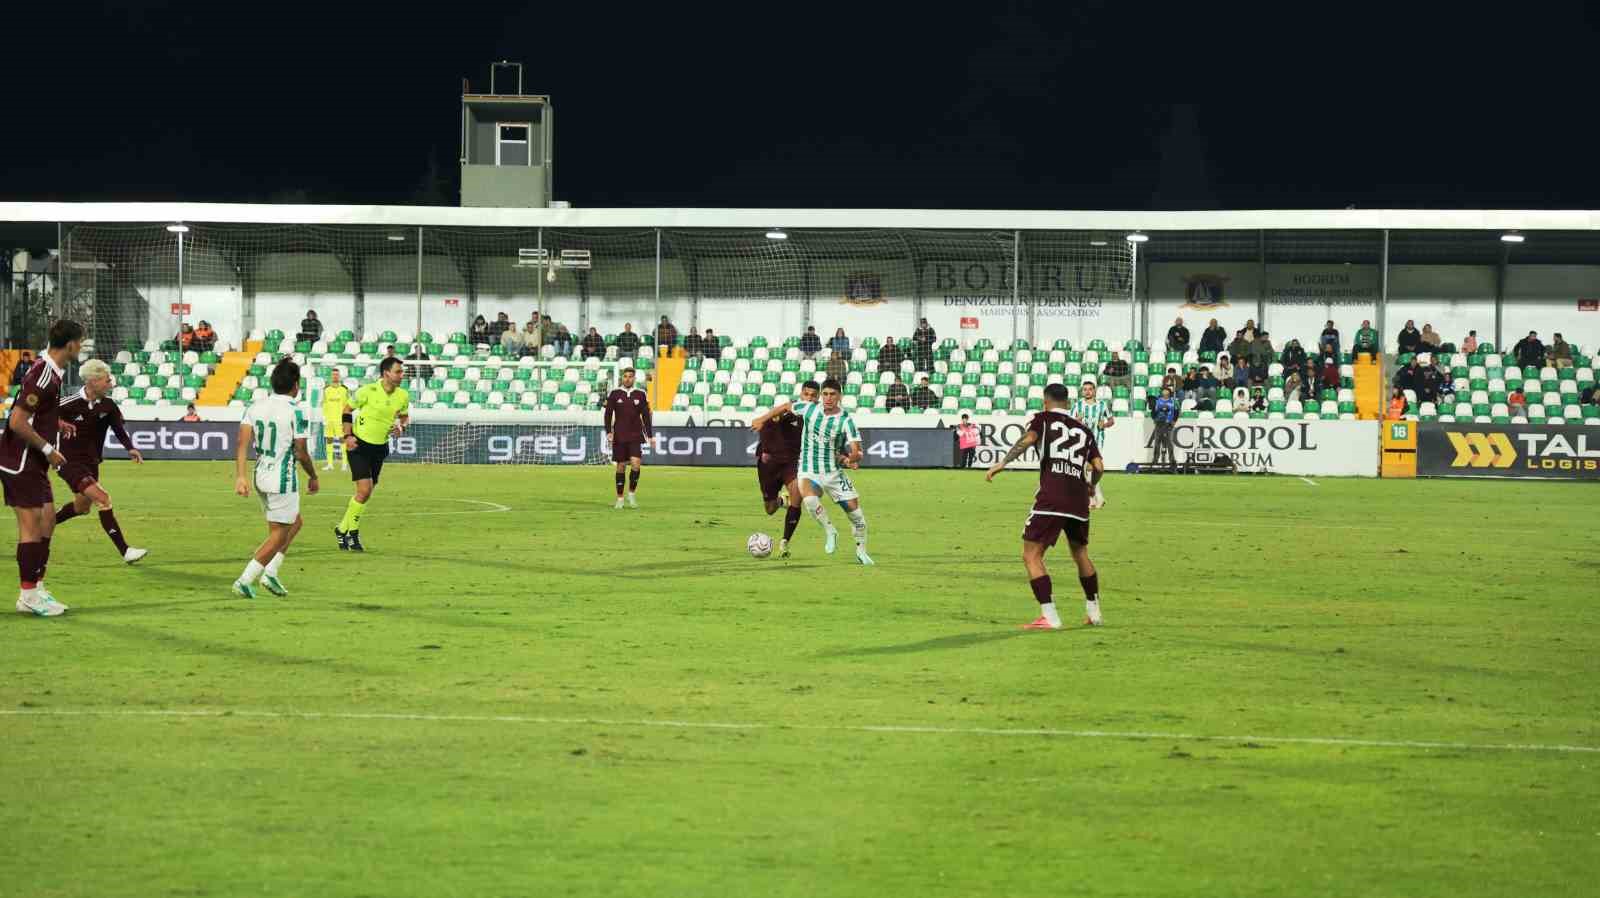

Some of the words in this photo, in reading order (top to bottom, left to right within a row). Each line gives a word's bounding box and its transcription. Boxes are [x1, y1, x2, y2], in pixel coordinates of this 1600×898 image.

[255, 419, 278, 457] 11
[487, 434, 586, 462] grey
[867, 440, 909, 459] 48
[1049, 421, 1087, 468] 22
[1518, 433, 1600, 458] TAL
